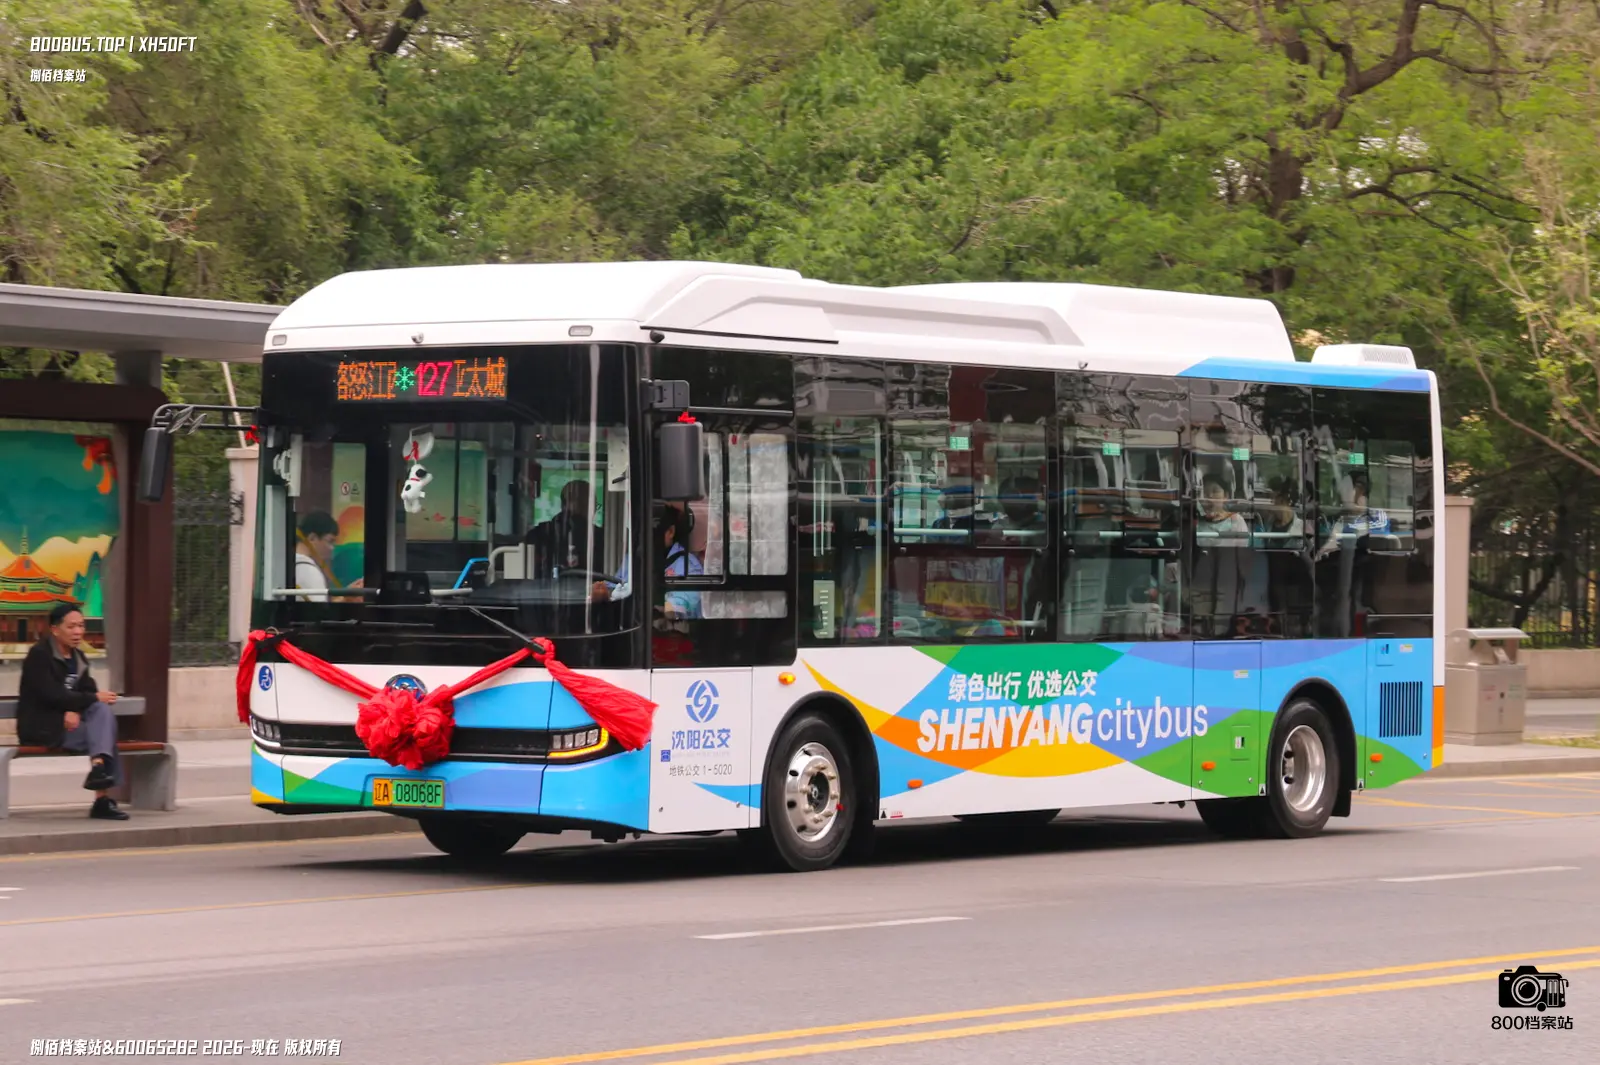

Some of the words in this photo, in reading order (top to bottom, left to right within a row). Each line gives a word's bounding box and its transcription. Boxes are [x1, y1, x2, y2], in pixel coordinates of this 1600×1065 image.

[415, 362, 453, 396] 127
[948, 672, 1021, 702] 绿色出行
[1026, 669, 1098, 698] 优选公交
[671, 727, 731, 750] 沈阳公交
[916, 702, 1094, 753] SHENYANG
[1096, 695, 1209, 748] citybus
[395, 783, 442, 804] 08068F
